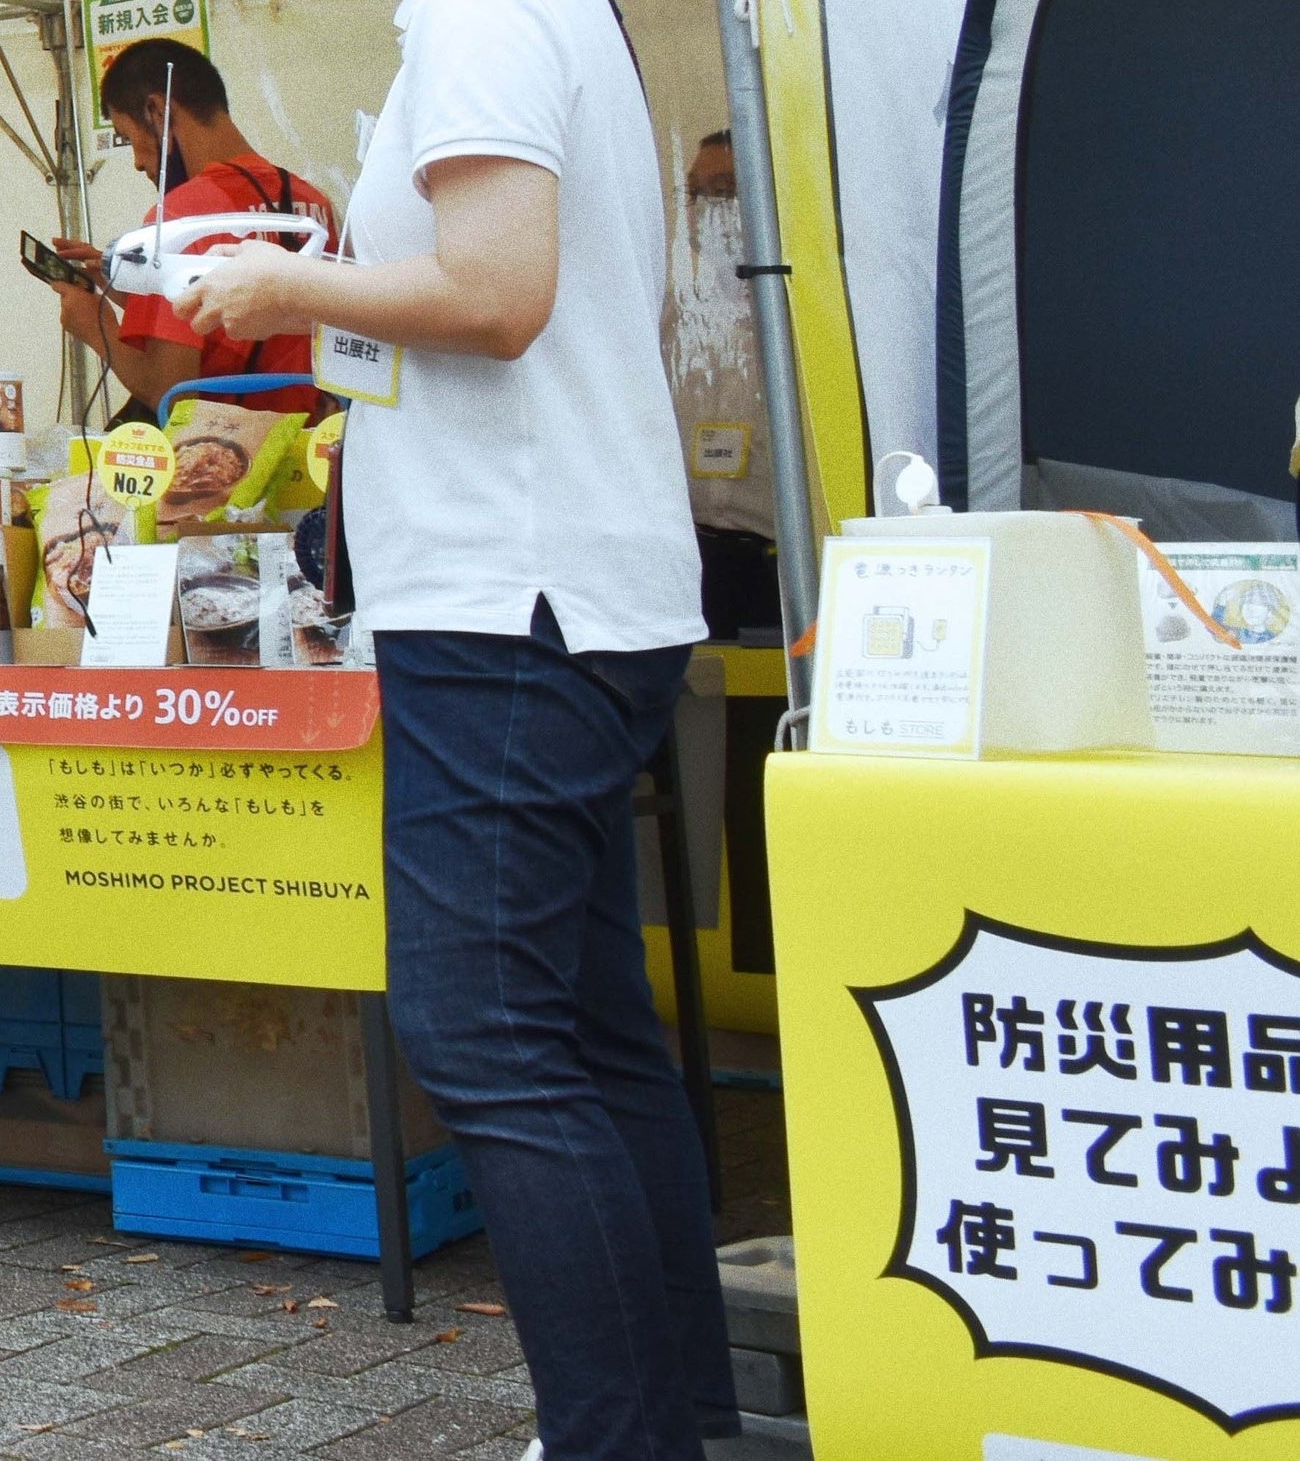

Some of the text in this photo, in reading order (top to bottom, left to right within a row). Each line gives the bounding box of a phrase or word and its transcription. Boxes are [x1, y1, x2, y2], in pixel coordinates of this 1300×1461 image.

[97, 3, 170, 36] 新規入会
[332, 335, 381, 364] 出展社
[113, 472, 154, 497] No.2
[846, 719, 894, 736] もしも
[900, 723, 944, 736] STORE
[47, 757, 353, 783] 「もしも」は「いつか」必ずやってくる。
[53, 792, 325, 818] 渋谷の街で、いろんな「もしも」を
[58, 827, 228, 849] 想像してみませんか。
[64, 869, 371, 901] MOSHIMO PROJECT SHIBUYA
[935, 1198, 1298, 1315] 使ってみ
